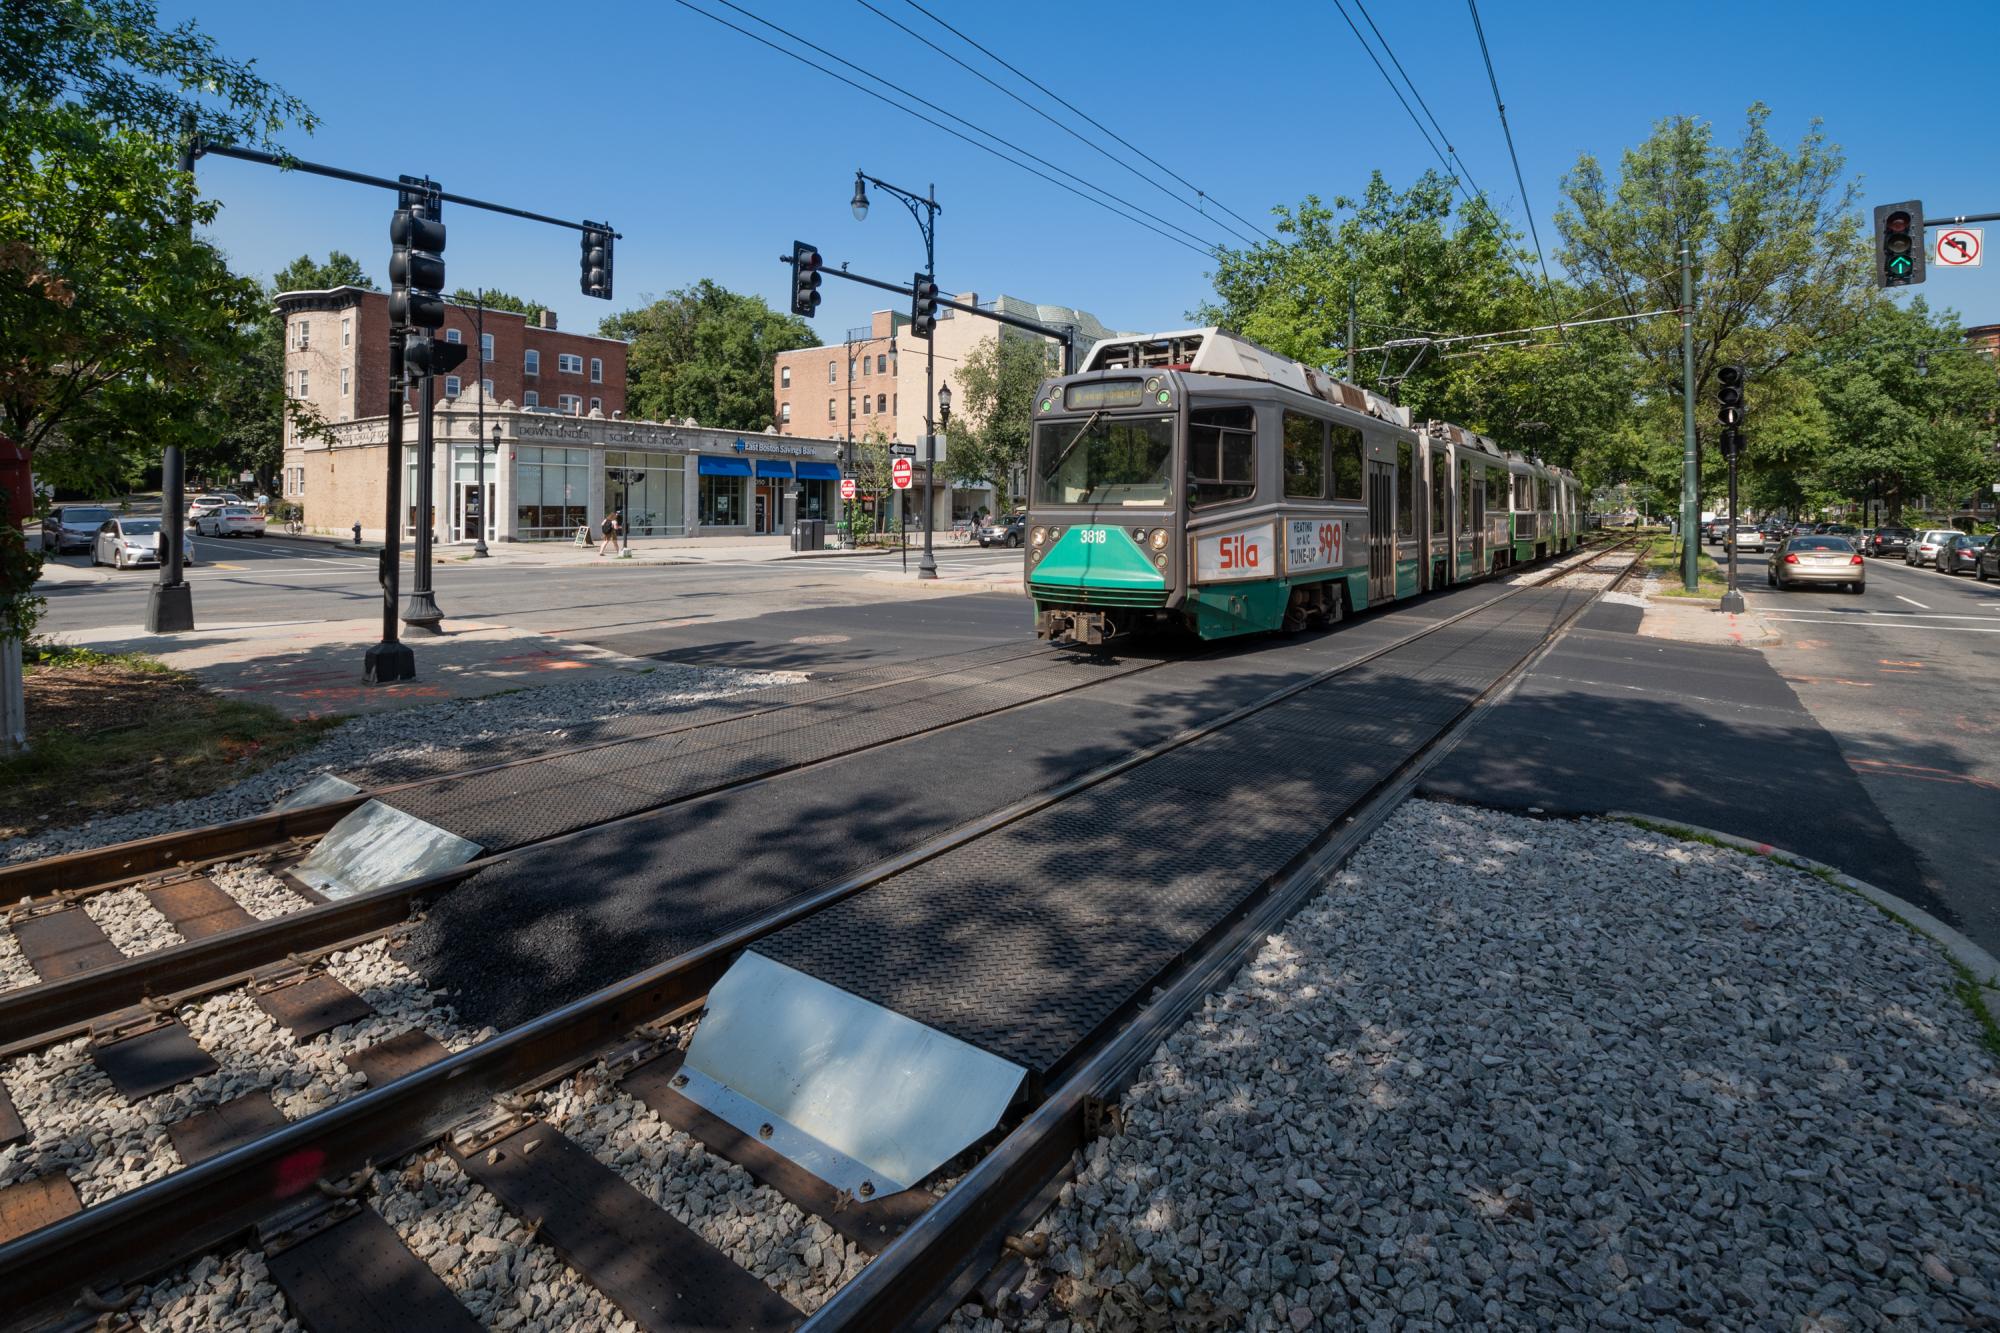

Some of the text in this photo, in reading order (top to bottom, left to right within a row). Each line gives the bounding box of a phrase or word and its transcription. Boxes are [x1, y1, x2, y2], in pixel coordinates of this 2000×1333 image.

[520, 427, 591, 440] DOWN UNDER
[609, 433, 683, 446] SCHOOL OF YOGA
[744, 441, 817, 456] East Boston Savings Bank
[1293, 521, 1313, 533] HEATING
[1080, 529, 1106, 544] 3818
[1302, 534, 1310, 545] A/C
[1319, 522, 1341, 564] $99
[1219, 534, 1259, 569] Sila
[1290, 547, 1317, 565] TUNE-UP
